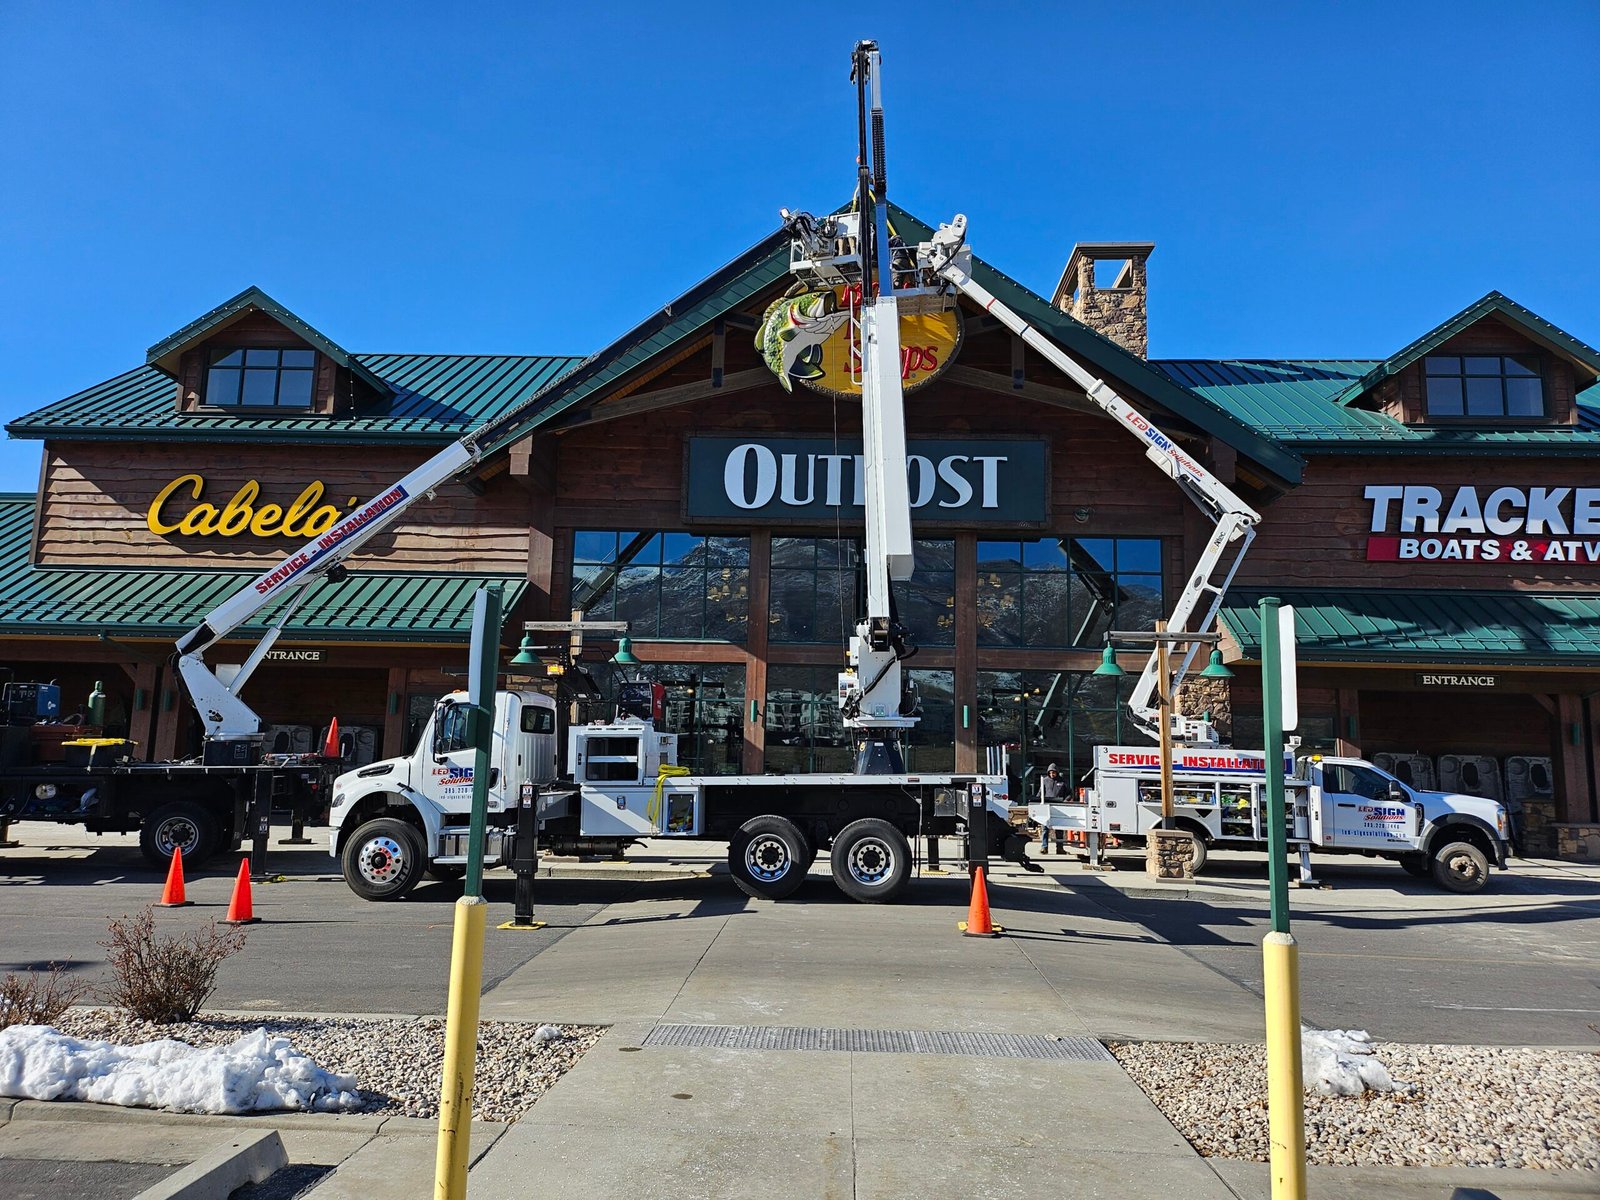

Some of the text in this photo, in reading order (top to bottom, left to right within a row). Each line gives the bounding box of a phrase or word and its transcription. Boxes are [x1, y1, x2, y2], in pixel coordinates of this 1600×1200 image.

[1125, 412, 1205, 478] LED SIGN Solutions
[147, 474, 366, 537] Cabela'
[255, 552, 310, 594] SERVICE
[317, 488, 403, 551] INSTALLATION
[1399, 538, 1500, 560] BOATS
[1510, 540, 1533, 560] &
[262, 650, 320, 660] NTRANCE
[1422, 675, 1495, 686] ENTRANCE
[1109, 753, 1161, 765] SERVIC
[432, 767, 474, 778] LED SIG
[1373, 807, 1405, 816] SIGN
